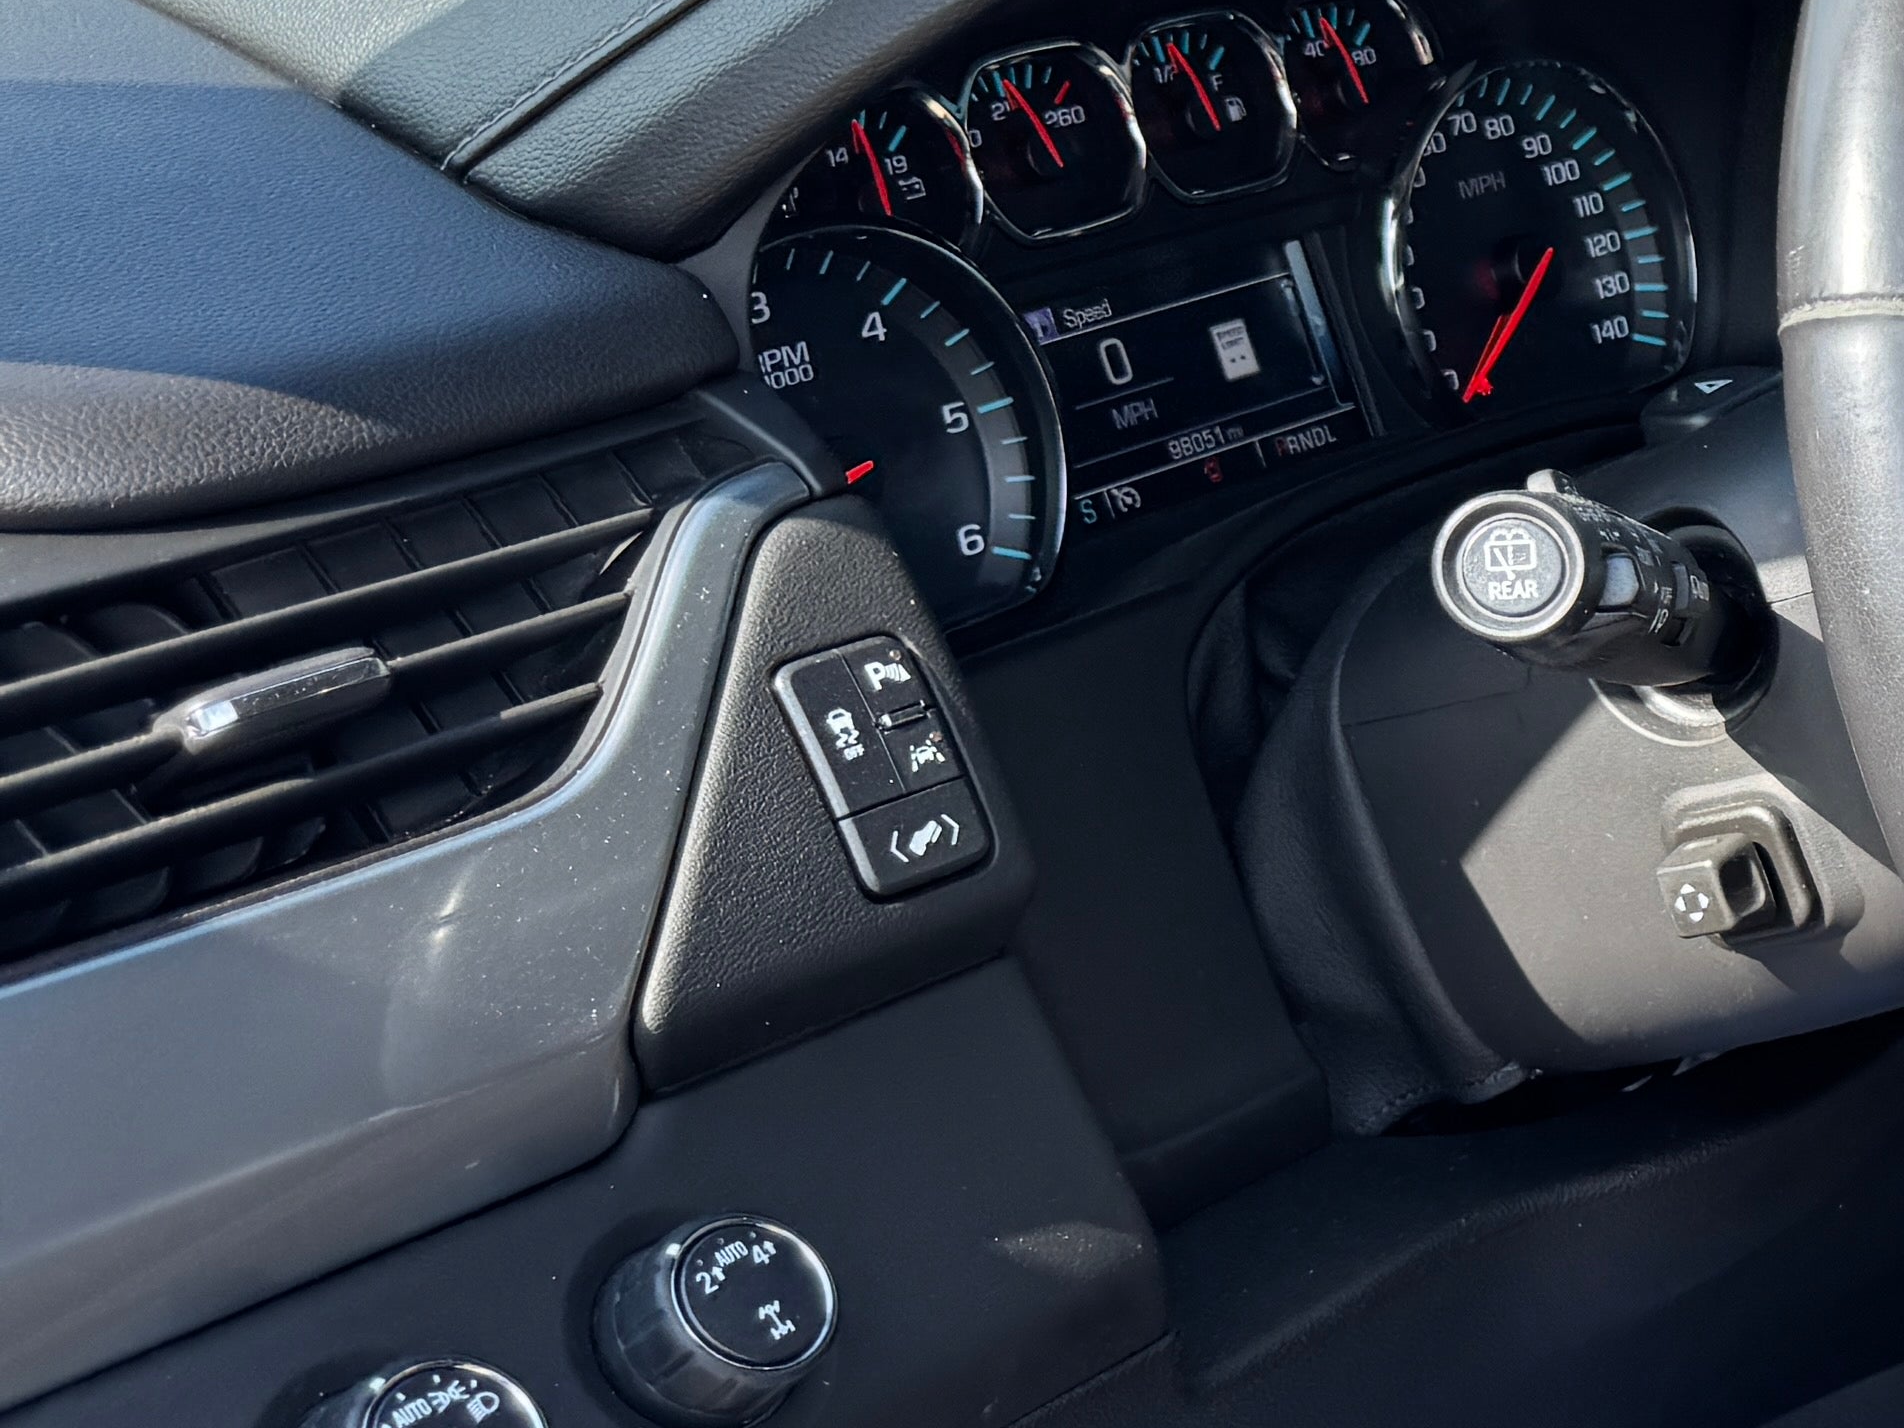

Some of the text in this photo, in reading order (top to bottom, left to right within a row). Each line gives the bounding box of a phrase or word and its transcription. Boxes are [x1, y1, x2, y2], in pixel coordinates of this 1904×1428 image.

[1352, 47, 1377, 66] 80
[1210, 74, 1224, 92] F
[1044, 104, 1086, 128] 260
[1448, 111, 1478, 137] 70
[1484, 114, 1515, 141] 80
[825, 146, 909, 175] 14 19
[1522, 134, 1553, 159] 90
[1457, 170, 1506, 200] MPH
[1541, 158, 1581, 187] 100
[1572, 192, 1604, 218] 110
[1584, 230, 1621, 259] 120
[1595, 272, 1630, 300] 130
[1062, 298, 1112, 329] Speed
[1592, 316, 1629, 344] 140
[759, 340, 811, 372] PM
[1099, 337, 1134, 386] 0
[750, 291, 986, 557] 3 4 5 6
[1111, 398, 1159, 431] MPH
[1079, 499, 1098, 524] S
[1488, 578, 1539, 601] REAR
[696, 1240, 771, 1295] 2 AUTO 4
